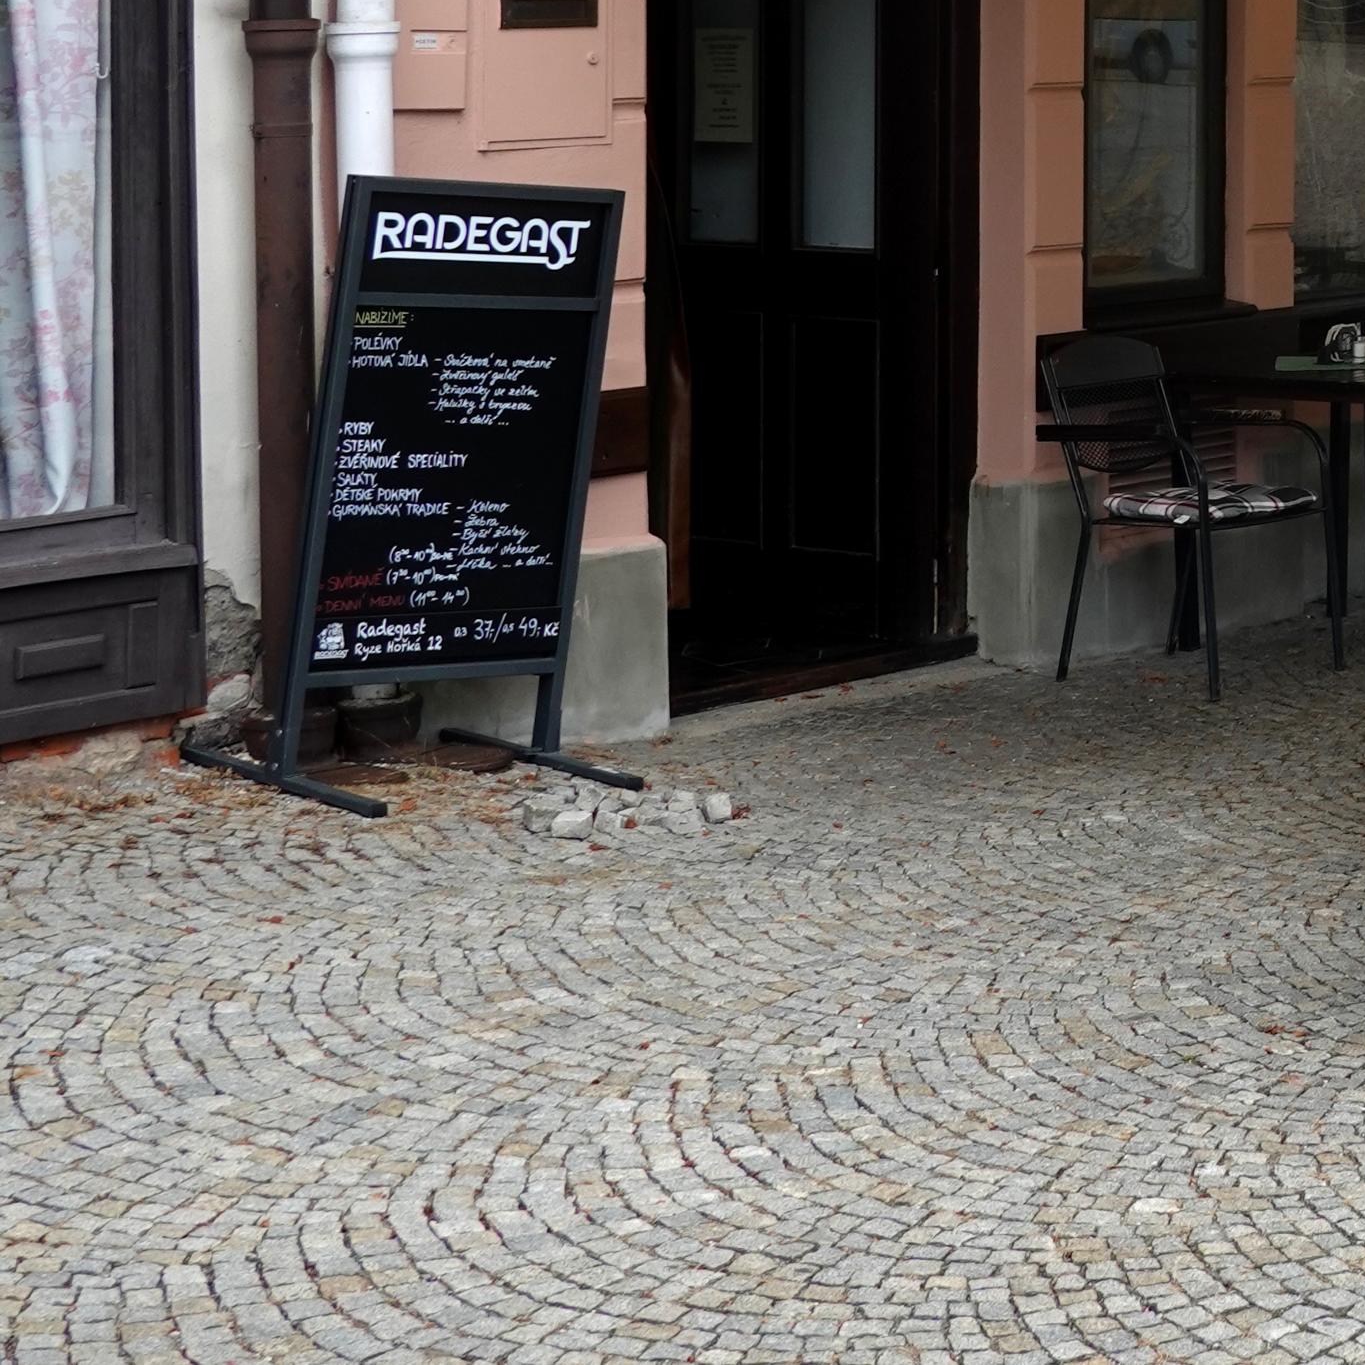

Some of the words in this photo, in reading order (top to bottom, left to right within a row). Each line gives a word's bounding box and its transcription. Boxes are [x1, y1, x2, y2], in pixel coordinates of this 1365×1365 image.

[372, 211, 591, 270] RADEGAST
[354, 332, 403, 350] POLÉVKY
[398, 350, 429, 367] JÍDLA
[344, 421, 375, 435] RYBY
[341, 439, 386, 453] STEAKY
[377, 488, 423, 502] POKRMY
[406, 502, 452, 517] TRADICE
[369, 595, 406, 608] MENU
[356, 618, 426, 642] Radegast
[543, 621, 560, 637] Kč
[427, 635, 442, 651] 12
